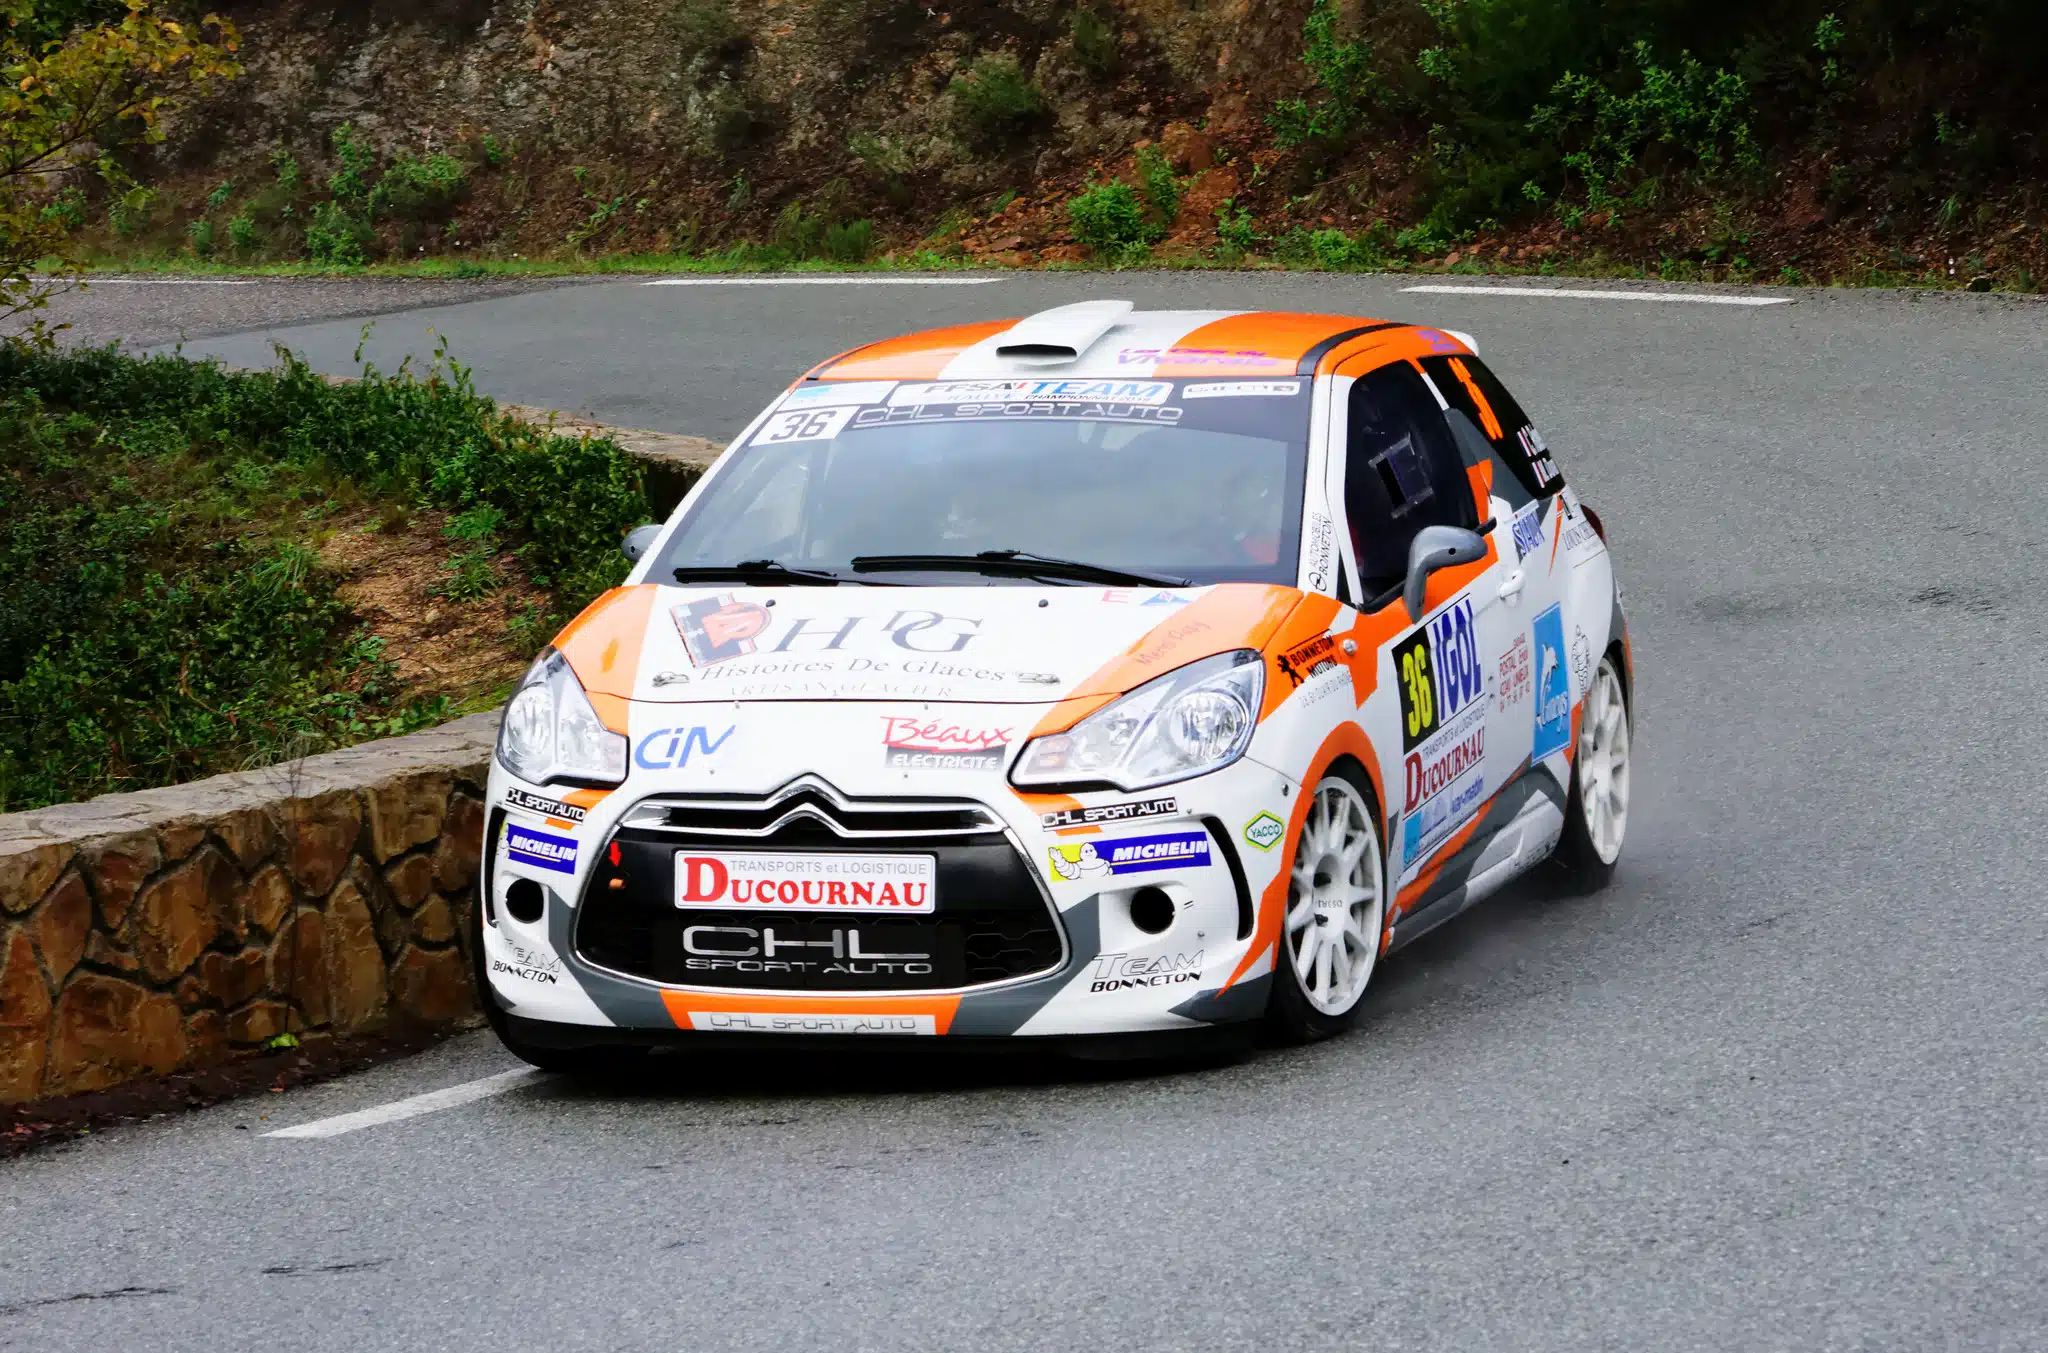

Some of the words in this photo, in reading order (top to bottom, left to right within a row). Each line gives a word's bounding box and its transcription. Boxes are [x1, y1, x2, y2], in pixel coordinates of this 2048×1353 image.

[1031, 381, 1164, 398] TEAM
[769, 410, 838, 441] 36
[855, 405, 944, 424] CHL
[954, 402, 1081, 416] SPORT
[1081, 404, 1183, 421] AUTO
[1318, 515, 1333, 576] BONNETON
[1289, 634, 1335, 668] BONNETON
[1432, 598, 1482, 721] IGOL
[699, 658, 834, 681] Histoires
[850, 657, 882, 674] De
[899, 659, 1007, 682] Glaces
[1306, 654, 1338, 679] MOTORS
[1402, 643, 1433, 737] 36
[880, 715, 1012, 750] Béaux
[1404, 727, 1485, 815] DUCOURNAU
[524, 793, 556, 814] SPORT
[554, 801, 586, 821] AUTO
[1042, 811, 1083, 827] CHL
[1084, 804, 1136, 822] SPORT
[1136, 798, 1177, 815] AUTO
[1251, 823, 1281, 838] YACCO
[511, 834, 577, 862] MICHELIN
[1112, 840, 1209, 862] MICHELIN
[682, 856, 928, 905] DUCOURNAU
[730, 860, 823, 875] TRANSPORTS
[826, 861, 840, 875] et
[842, 860, 927, 876] LOGISTIQUE
[682, 925, 931, 960] CHL
[492, 959, 559, 985] BONNETON
[684, 958, 817, 974] SPORT
[823, 959, 933, 975] AUTO
[1091, 949, 1205, 980] TEAM
[1089, 970, 1203, 994] BONNETON
[708, 1014, 768, 1030] CHL
[772, 1015, 850, 1031] SPORT
[853, 1014, 917, 1031] AUTO
